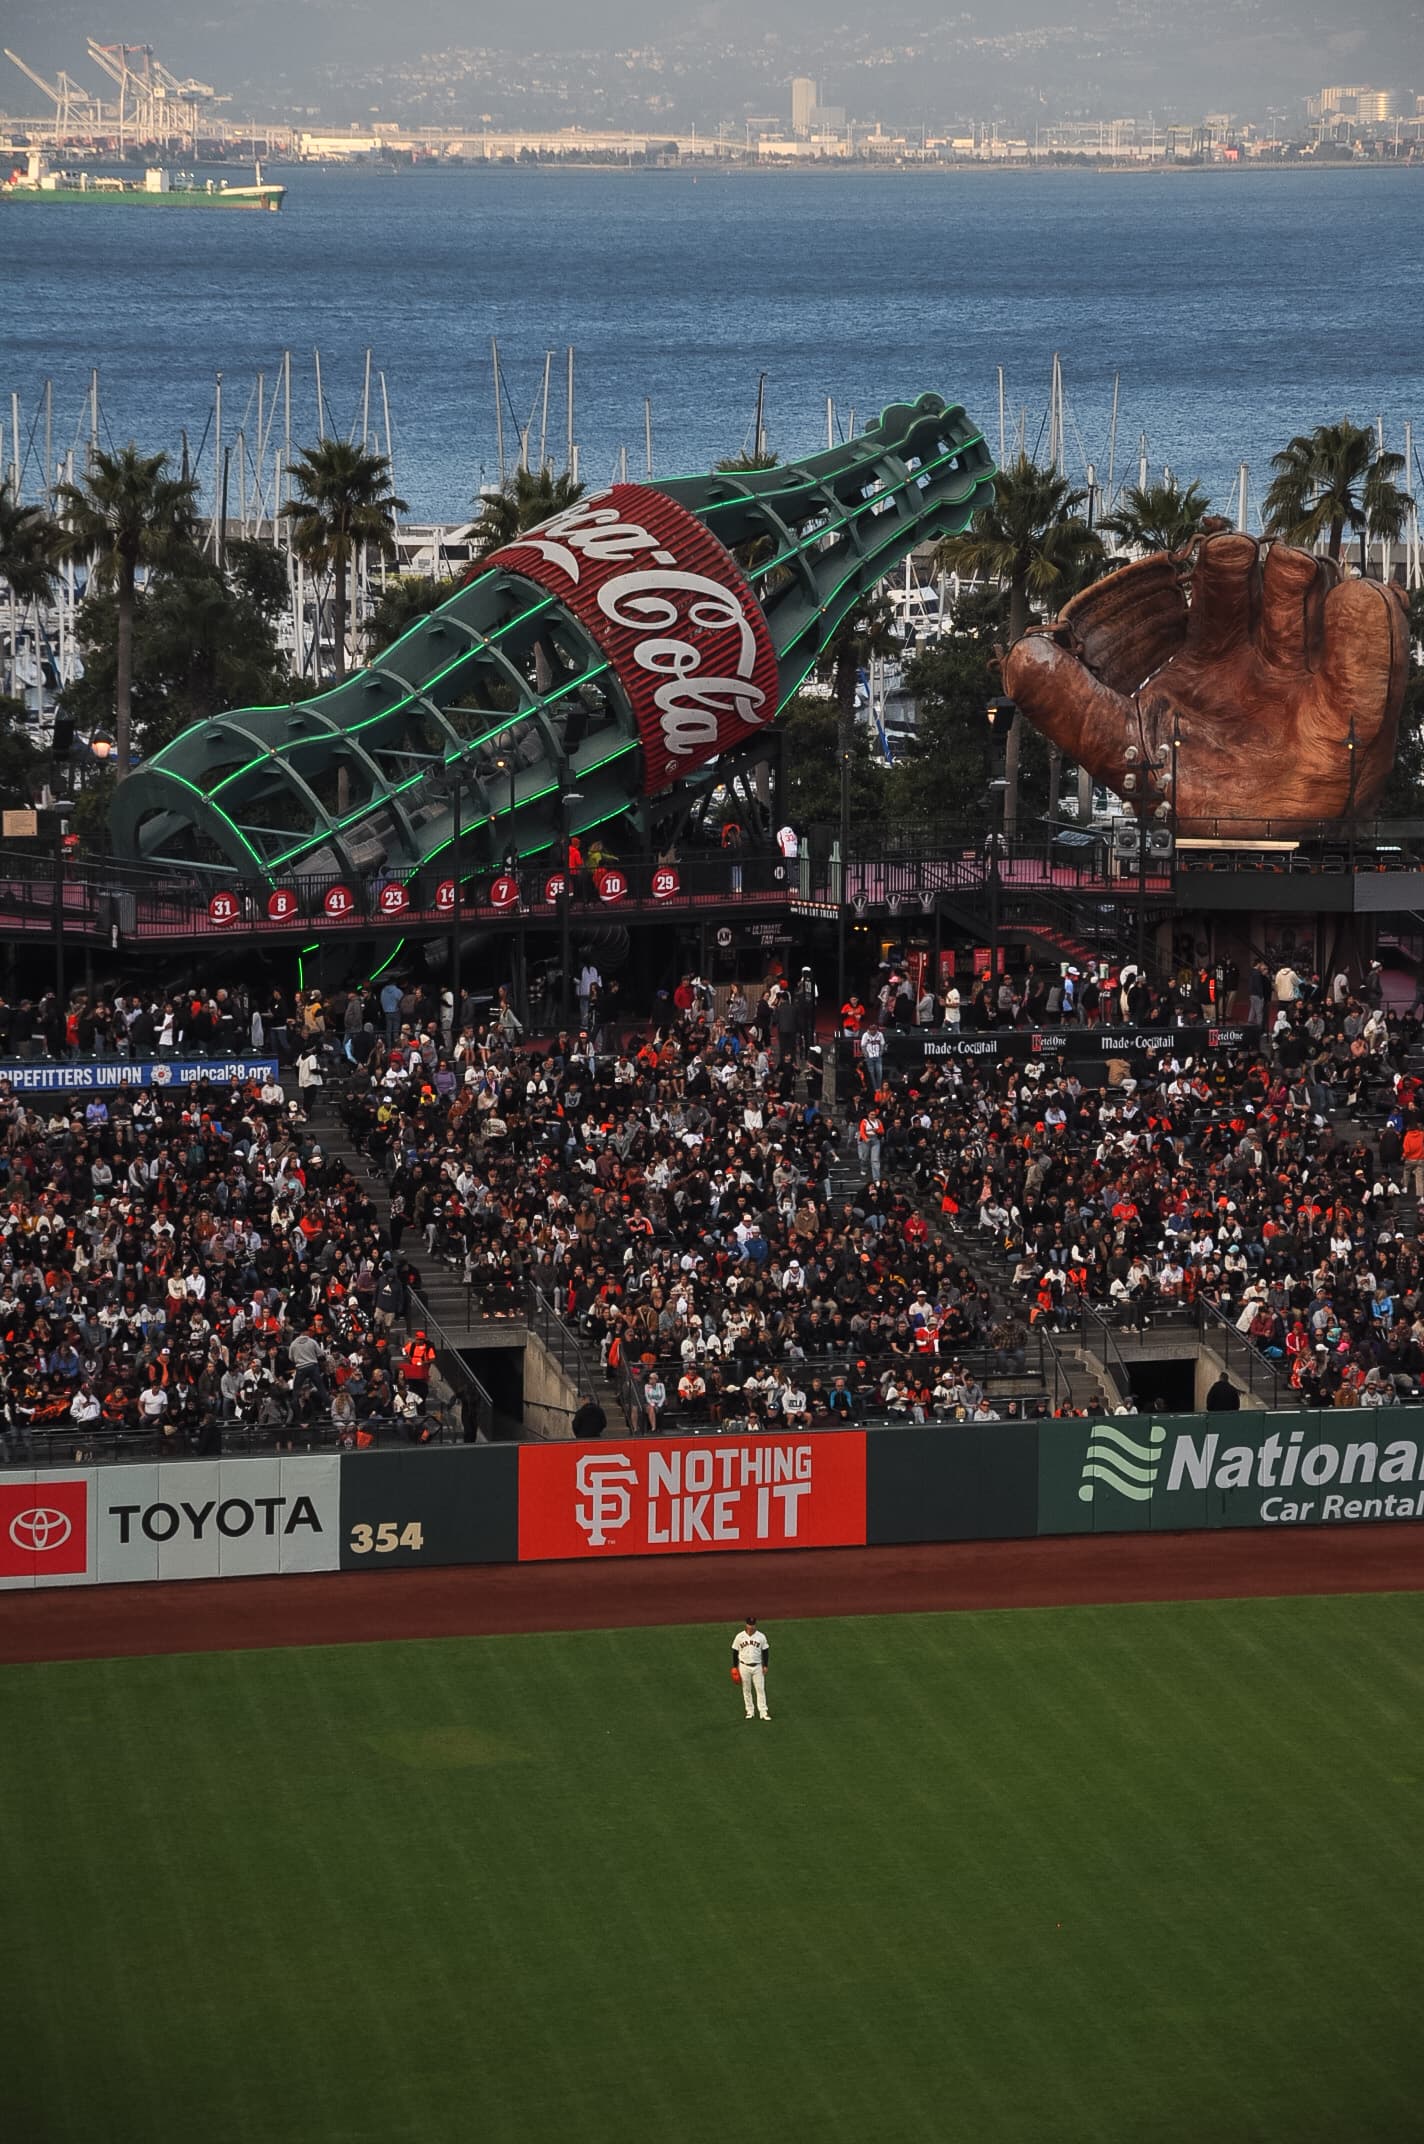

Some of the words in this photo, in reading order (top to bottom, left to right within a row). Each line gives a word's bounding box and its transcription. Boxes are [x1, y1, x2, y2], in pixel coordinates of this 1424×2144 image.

[484, 488, 765, 755] oca-Cola
[605, 878, 620, 893] 10
[657, 875, 674, 890] 29
[385, 891, 403, 906] 23
[440, 887, 455, 903] 14
[498, 884, 509, 899] 7
[214, 900, 231, 916] 31
[276, 897, 287, 912] 8
[328, 894, 346, 909] 41
[1052, 1036, 1067, 1046] One
[1101, 1036, 1129, 1050] Made
[1229, 1031, 1244, 1041] One
[924, 1042, 952, 1055] Made
[96, 1066, 142, 1085] UNION
[180, 1064, 272, 1083] ualocal38.org
[1166, 1431, 1424, 1491] Nationa
[648, 1446, 812, 1498] NOTHING
[575, 1453, 639, 1546] SF
[1260, 1496, 1315, 1522] Car
[1321, 1490, 1424, 1520] Rental
[108, 1495, 323, 1544] TOYOTA
[647, 1491, 741, 1544] LIKE
[756, 1482, 812, 1539] IT
[350, 1521, 424, 1554] 354
